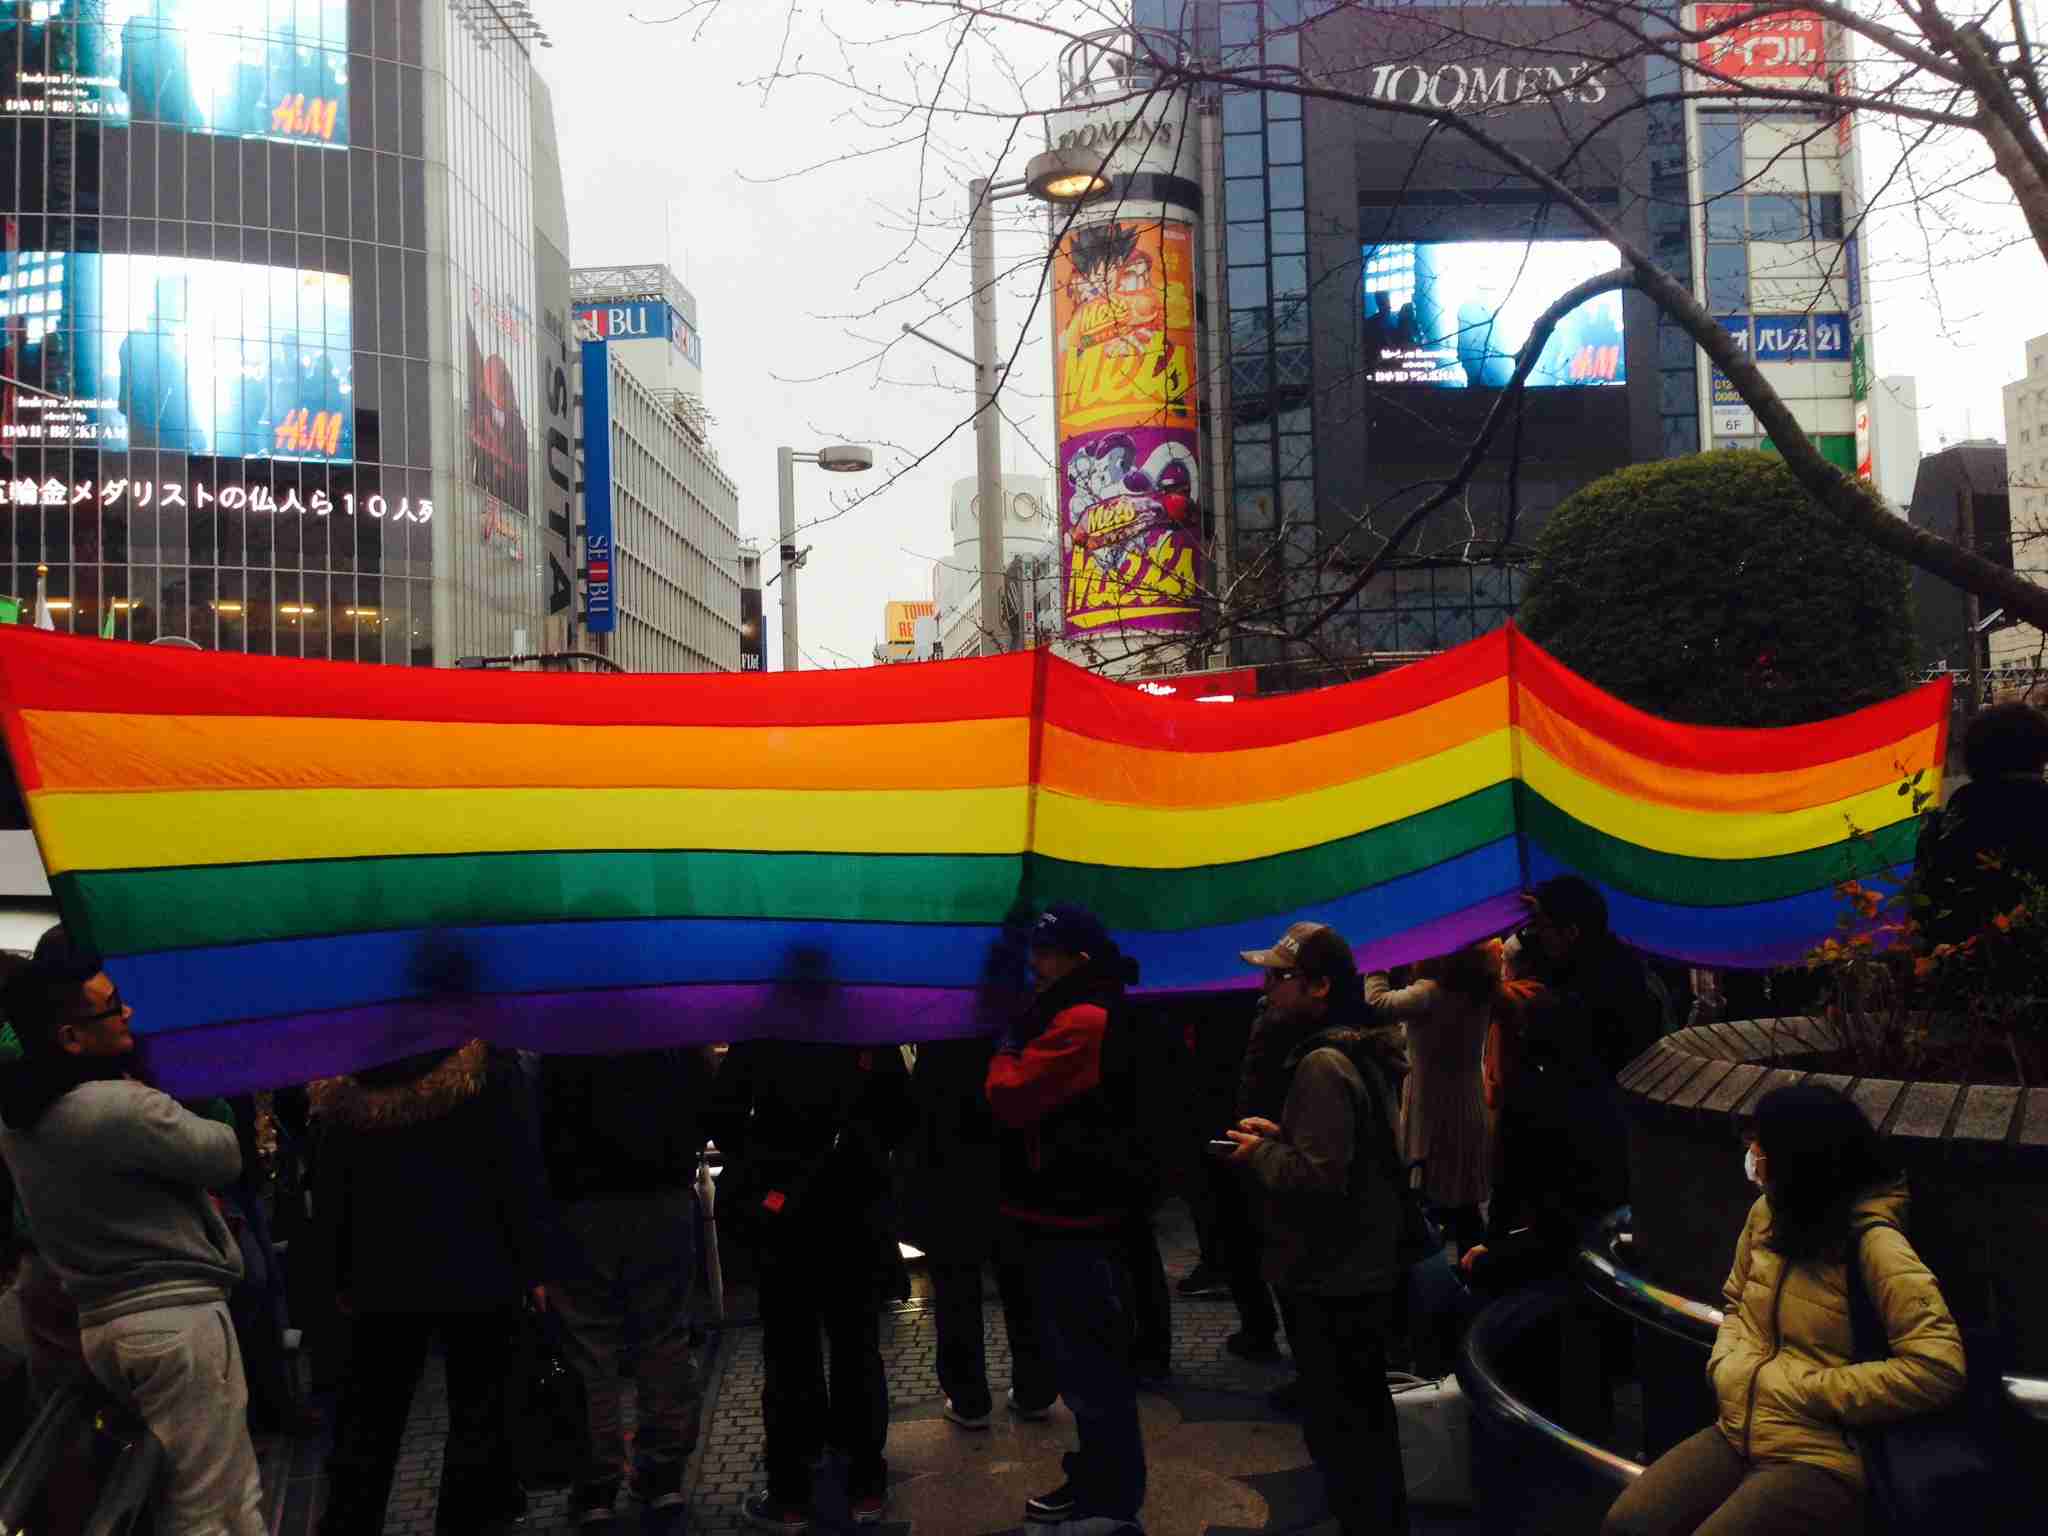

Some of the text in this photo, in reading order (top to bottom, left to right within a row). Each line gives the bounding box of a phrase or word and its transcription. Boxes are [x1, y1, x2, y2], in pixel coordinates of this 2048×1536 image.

[1730, 324, 1841, 351] オパレス21
[587, 535, 609, 613] SEIBU
